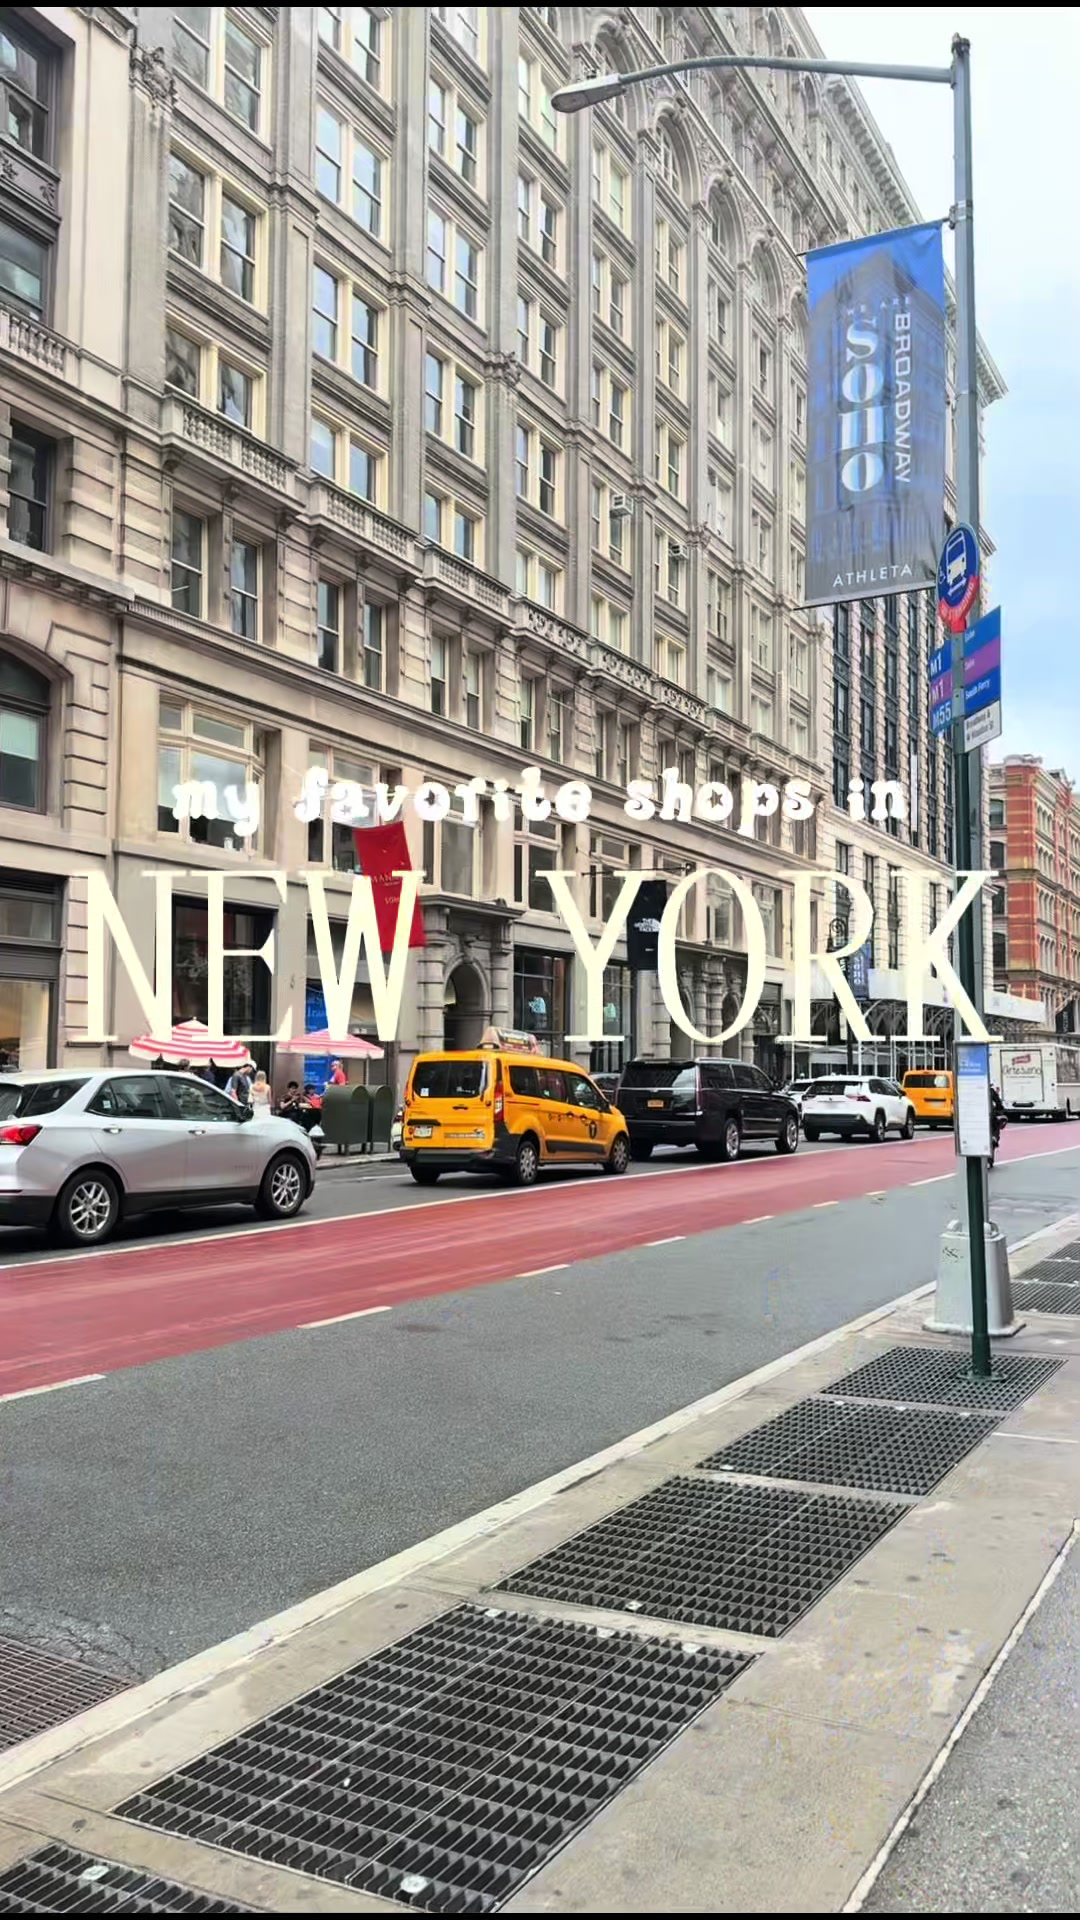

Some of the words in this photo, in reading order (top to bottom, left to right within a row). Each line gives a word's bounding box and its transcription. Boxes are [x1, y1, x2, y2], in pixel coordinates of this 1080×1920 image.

[895, 312, 911, 483] BROADWAY
[832, 564, 913, 588] ATHLETA
[930, 651, 942, 676] M1
[931, 677, 944, 704] M1
[932, 701, 951, 730] M55
